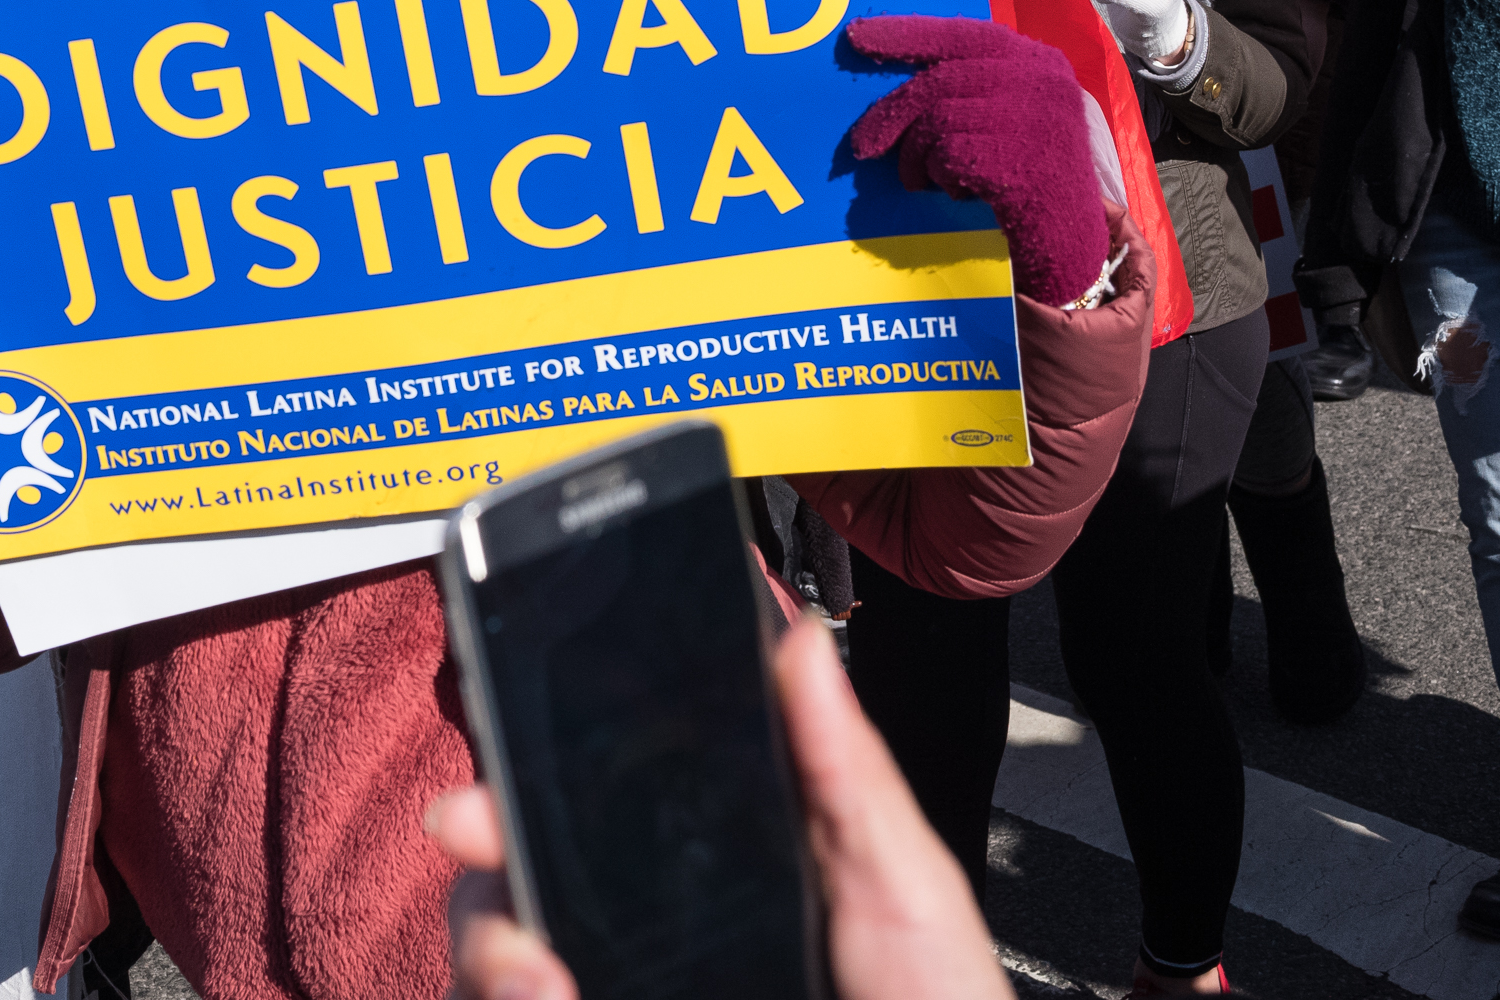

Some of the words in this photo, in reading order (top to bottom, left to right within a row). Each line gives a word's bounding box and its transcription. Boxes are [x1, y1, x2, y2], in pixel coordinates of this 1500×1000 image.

[50, 107, 804, 327] JUSTICIA
[87, 397, 239, 433] NATIONAL
[245, 386, 357, 418] LATINA
[364, 366, 515, 404] INSTITUTE
[593, 324, 830, 373] REPRODUCTIVE
[839, 312, 958, 344] HEALTH
[95, 438, 230, 470] INSTITUTO
[238, 422, 386, 456] NACIONAL
[436, 399, 555, 434] LATINAS
[688, 372, 786, 402] SALUD
[794, 359, 1001, 391] REPRODUCTIVA
[110, 459, 503, 516] www.LatinaInstitute.org
